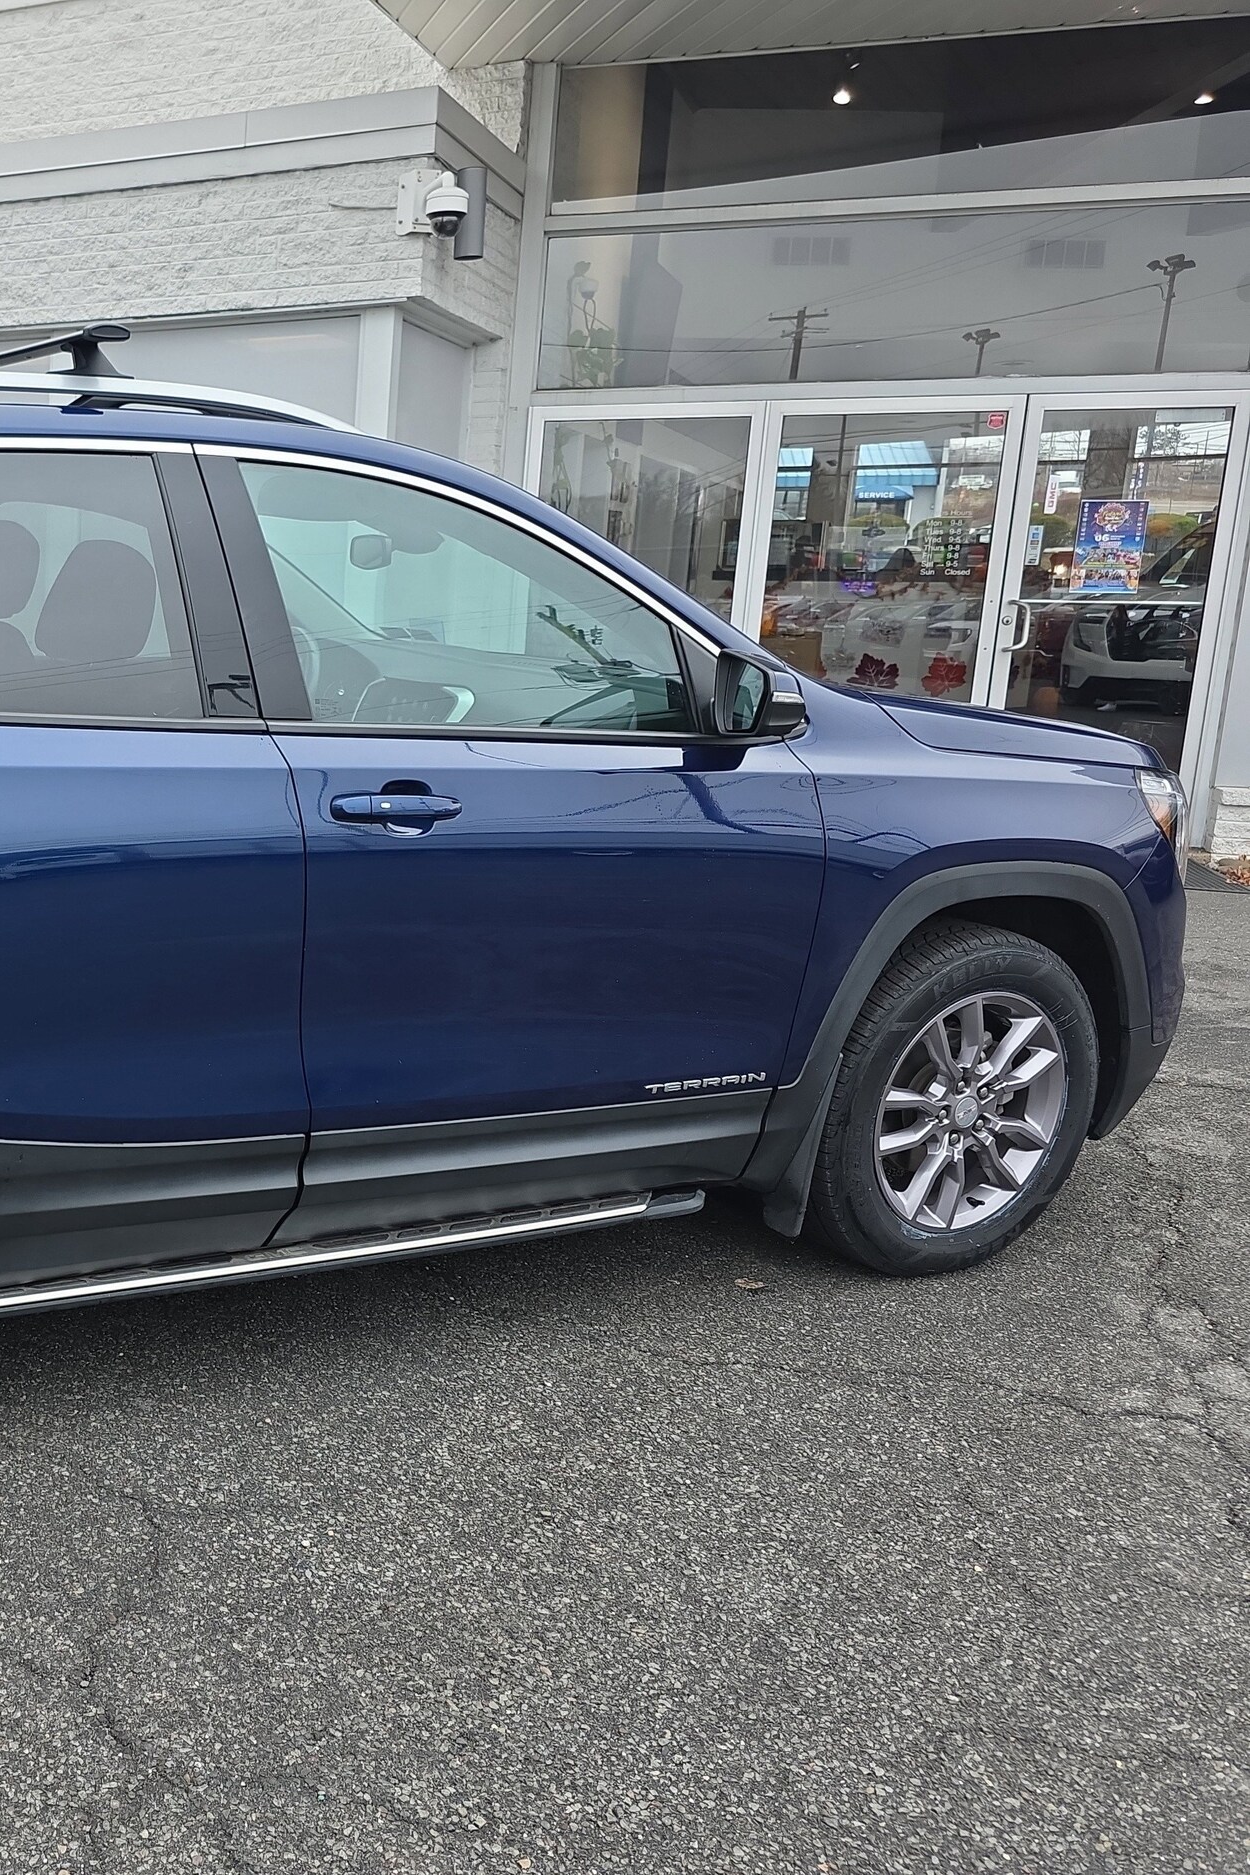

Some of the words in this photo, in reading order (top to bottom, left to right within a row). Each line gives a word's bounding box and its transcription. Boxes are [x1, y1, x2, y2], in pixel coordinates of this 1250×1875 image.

[926, 519, 942, 527] Mon
[950, 519, 963, 527] 9-8
[949, 528, 962, 536] 9-8
[947, 544, 960, 552] 9-8
[946, 552, 959, 560] 9-8
[644, 1071, 766, 1095] TERRAIN
[245, 1246, 308, 1262] GMC
